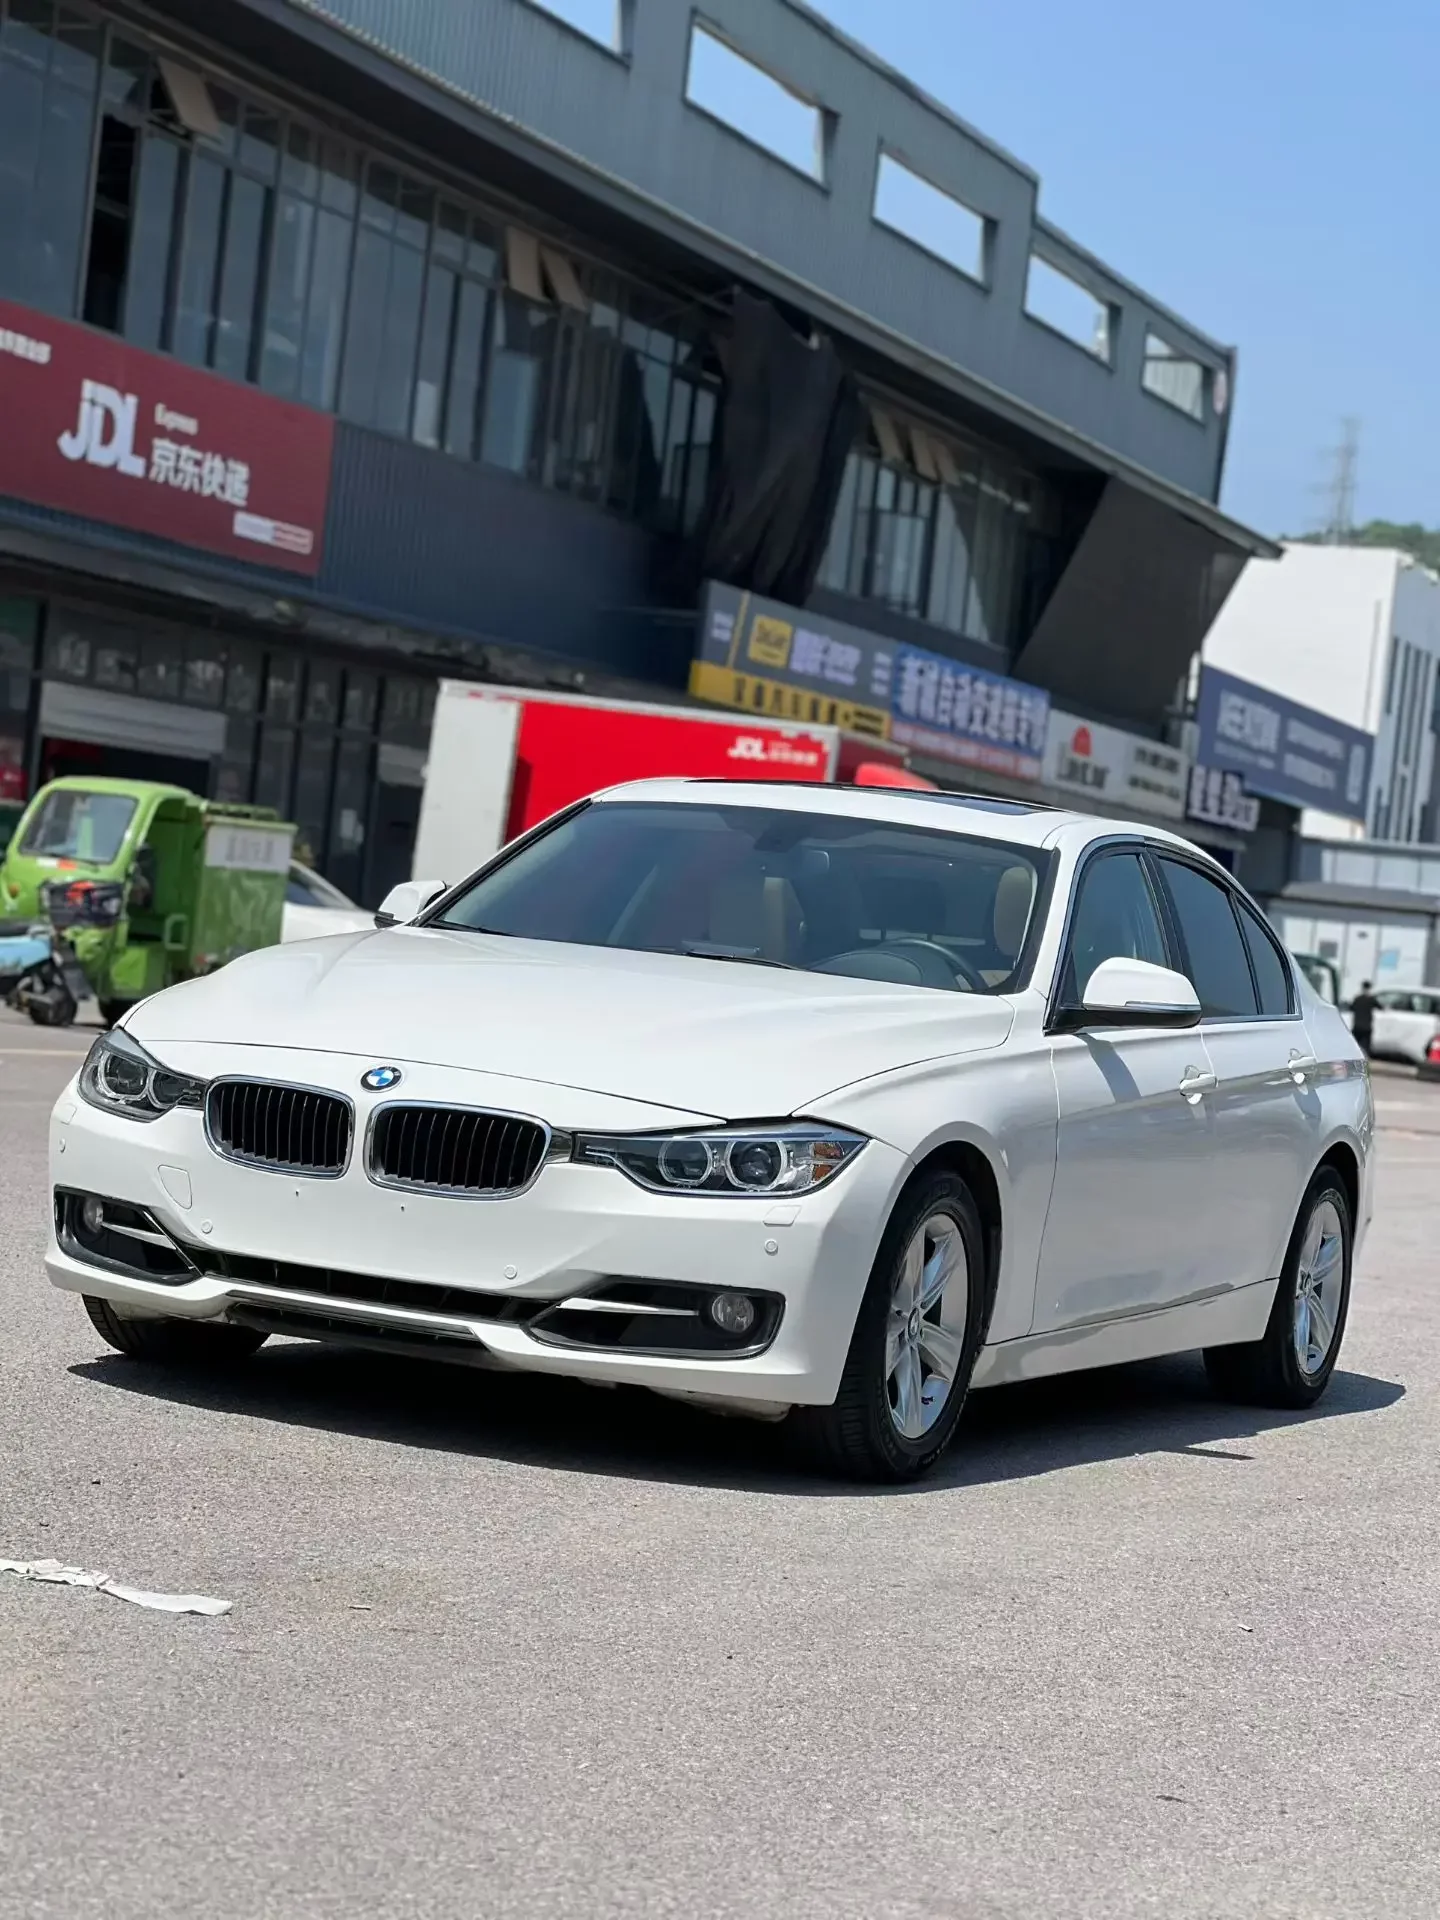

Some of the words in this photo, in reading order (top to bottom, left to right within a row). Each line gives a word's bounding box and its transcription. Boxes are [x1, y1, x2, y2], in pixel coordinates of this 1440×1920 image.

[57, 378, 146, 478] JDL
[150, 436, 251, 507] 京东快递
